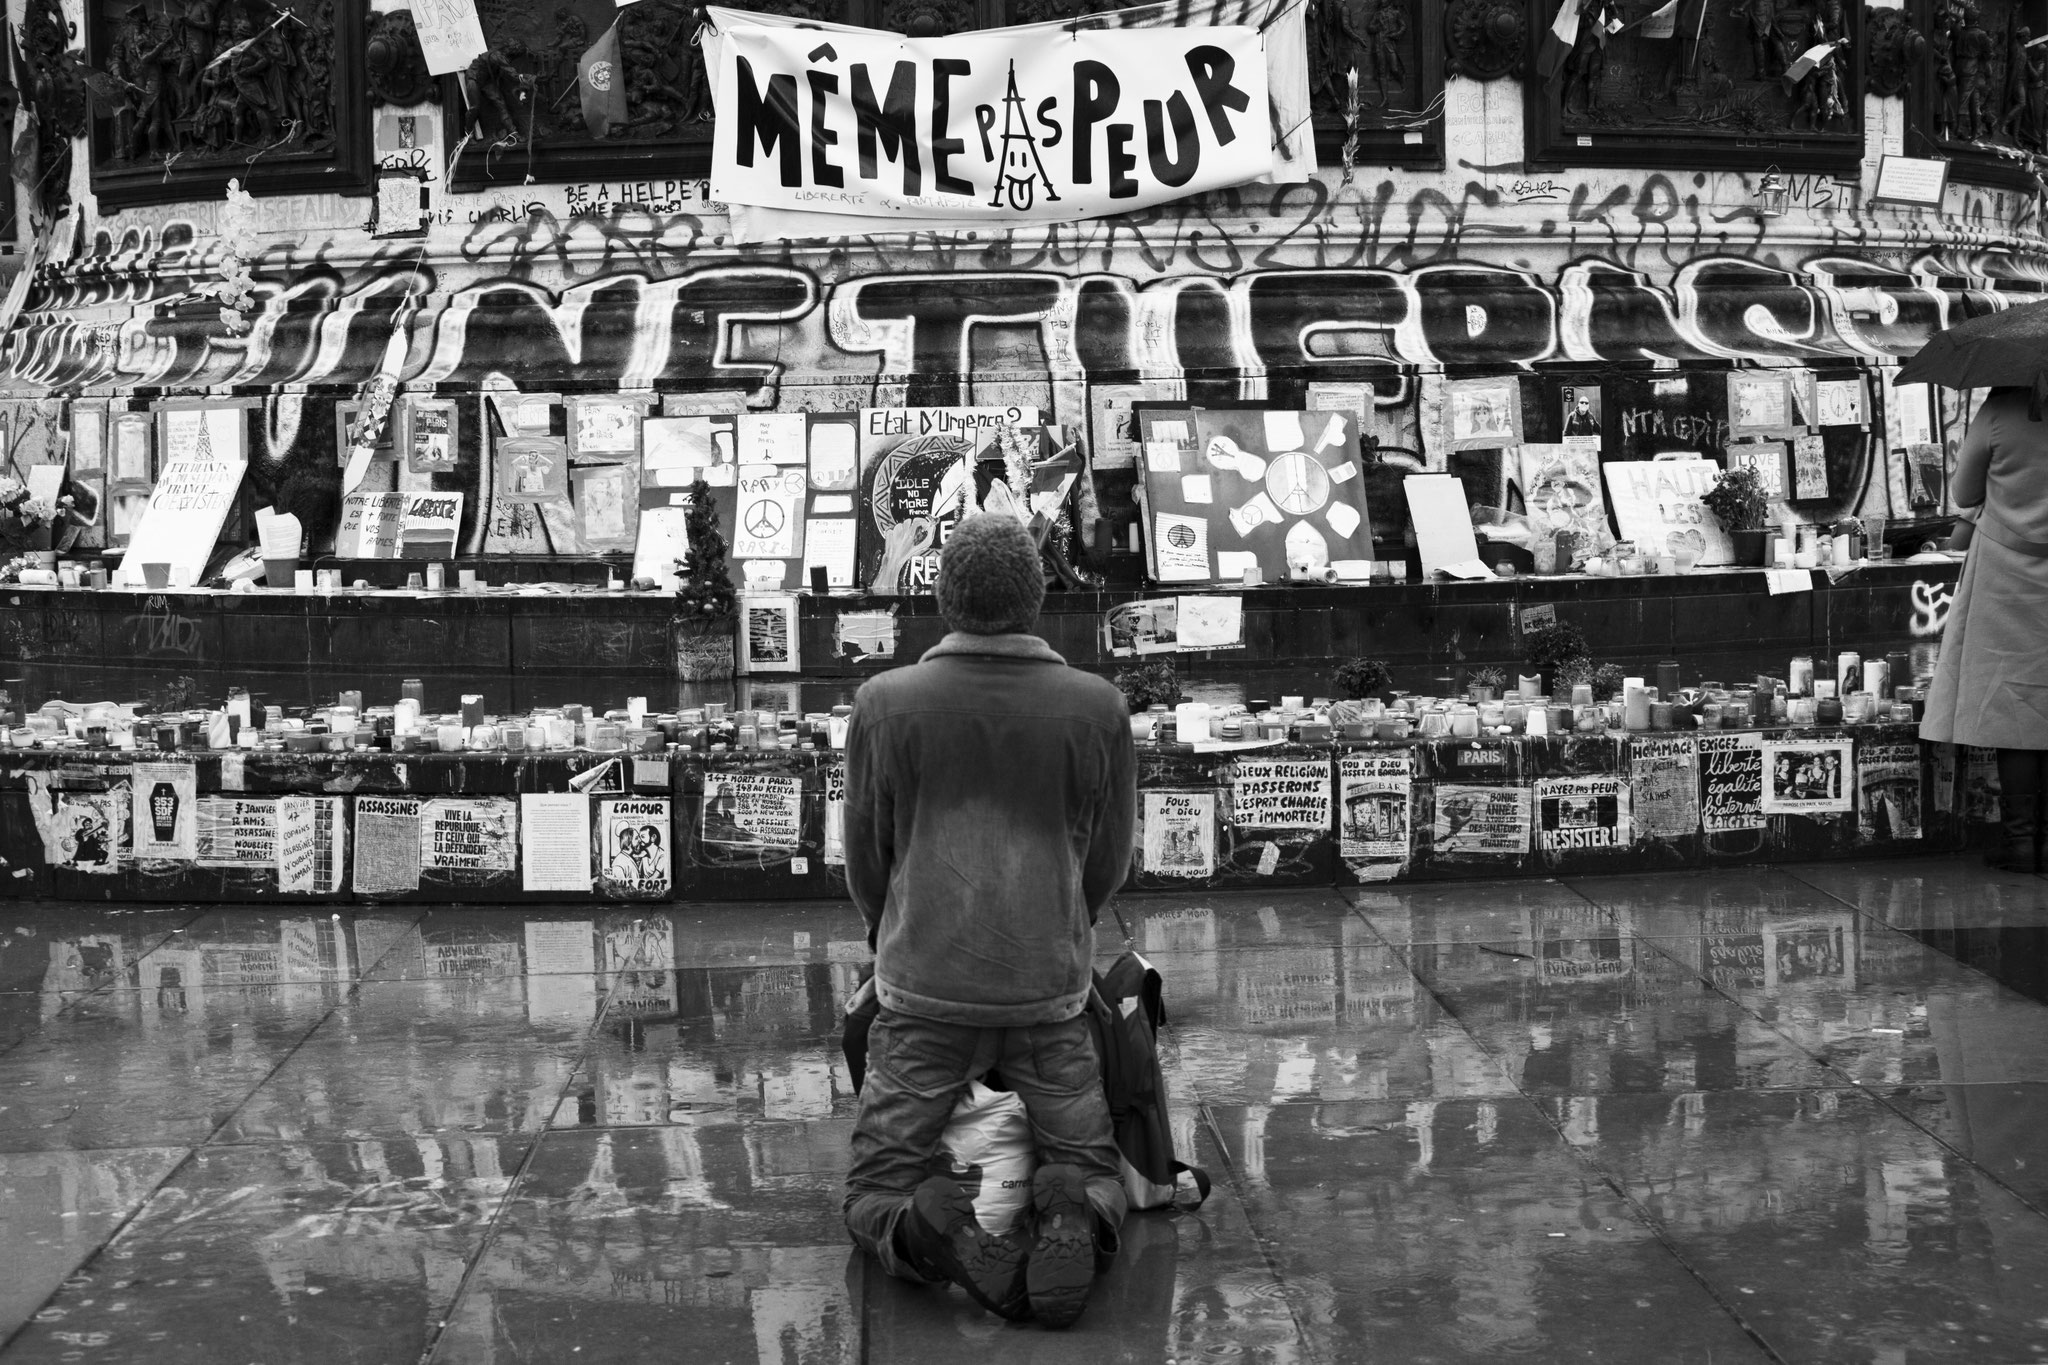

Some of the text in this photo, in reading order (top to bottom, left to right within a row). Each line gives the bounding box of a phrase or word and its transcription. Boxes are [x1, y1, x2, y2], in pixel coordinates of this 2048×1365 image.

[1457, 91, 1500, 114] BON
[736, 42, 1250, 209] MÊME PAS PEUR
[565, 184, 588, 204] BE
[598, 184, 608, 201] A
[256, 196, 336, 222] ISSEAU
[870, 410, 912, 436] Etat
[1622, 407, 1668, 440] NTM
[1739, 454, 1774, 467] LOVE
[896, 478, 929, 489] IDLE
[1627, 466, 1714, 500] HAUT
[907, 489, 919, 498] NO
[345, 496, 370, 506] NOTRE
[1658, 503, 1703, 524] LES
[344, 522, 380, 534] QUE VOS
[737, 540, 790, 554] PARIS
[1632, 741, 1692, 759] HOMMAGE
[1464, 750, 1501, 764] PARIS
[1705, 750, 1762, 775] liberté
[1969, 753, 1984, 762] QUE
[1342, 761, 1359, 769] FOU
[1380, 760, 1402, 768] DiEU
[1342, 769, 1376, 777] ASSEZ DE
[708, 774, 727, 782] 147
[731, 775, 755, 784] MORTS
[736, 784, 795, 794] 148 AU KENYA
[1379, 782, 1401, 791] BAR
[1576, 785, 1588, 794] PAS
[1591, 782, 1619, 794] PEUR
[1709, 774, 1762, 806] égalité
[154, 797, 173, 806] 353
[1165, 796, 1190, 807] FOUS
[1490, 793, 1518, 802] BONNE
[155, 807, 174, 816] SDF
[613, 802, 664, 815] L'AMOUR
[1160, 807, 1201, 816] DE DiEU
[288, 811, 300, 822] 17
[444, 809, 473, 822] VIVE LA
[1235, 813, 1254, 824] EST
[232, 817, 240, 826] 12
[234, 828, 278, 838] ASSASSiNE
[434, 831, 480, 844] ET CEUX QUI
[434, 842, 444, 852] LA
[1186, 868, 1209, 876] NOUS
[637, 878, 668, 891] FORT
